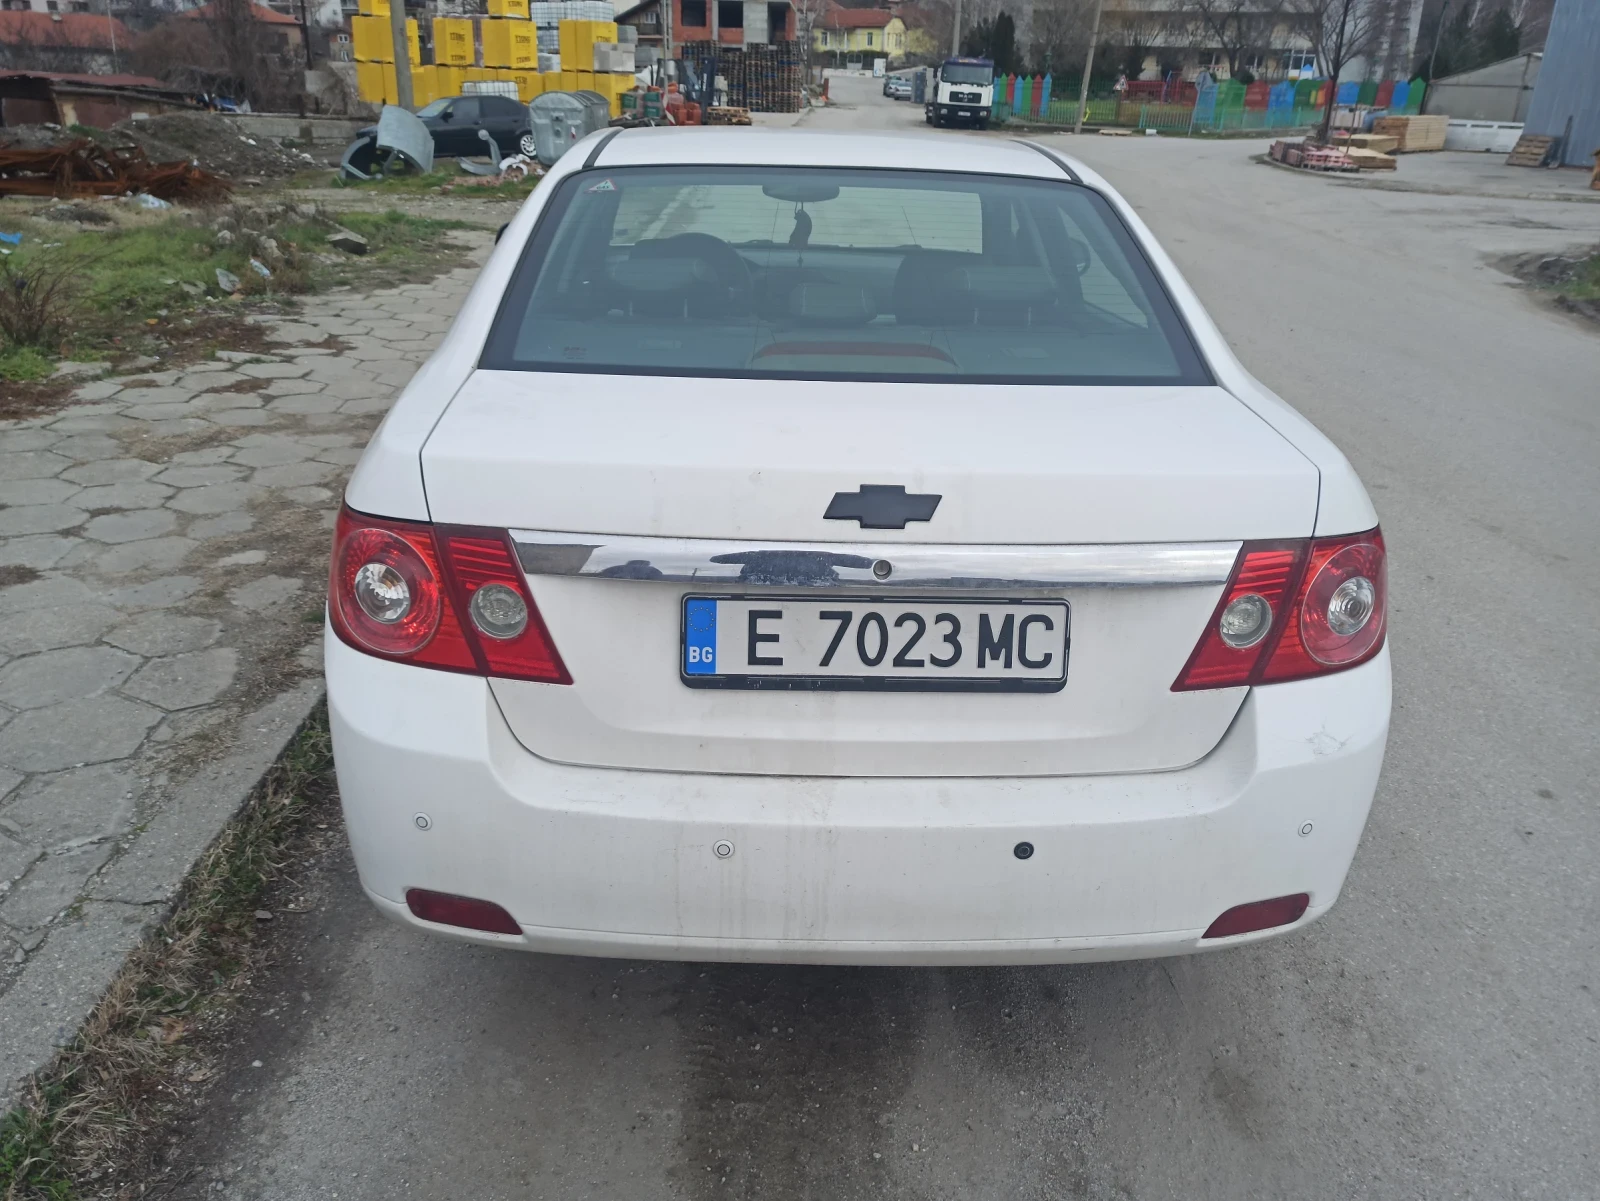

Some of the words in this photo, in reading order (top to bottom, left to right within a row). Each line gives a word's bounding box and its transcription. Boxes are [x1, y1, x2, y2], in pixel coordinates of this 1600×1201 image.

[689, 646, 713, 663] BG
[747, 609, 784, 666] E
[818, 610, 963, 669] 7023
[977, 612, 1054, 669] MC
